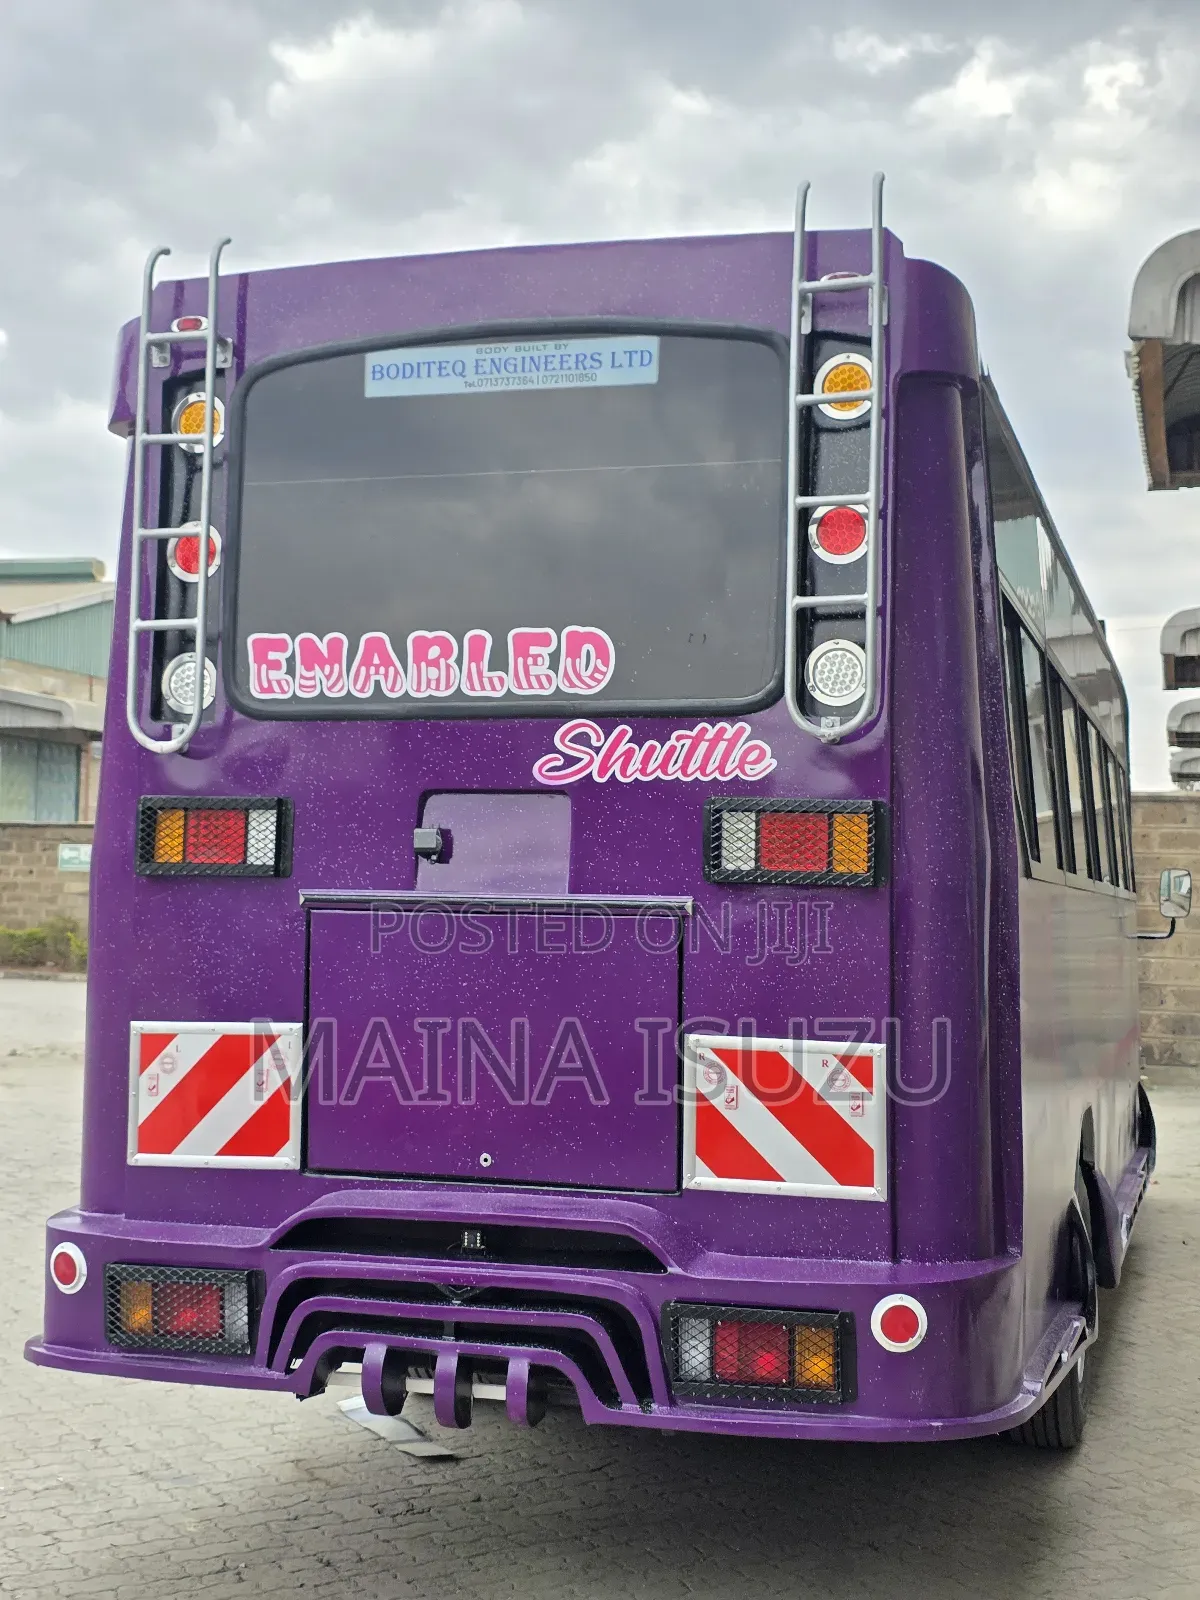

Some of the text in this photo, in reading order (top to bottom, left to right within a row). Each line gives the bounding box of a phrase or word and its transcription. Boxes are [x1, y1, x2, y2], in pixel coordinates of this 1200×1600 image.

[371, 349, 653, 381] BODITEQ ENGINEERS LTD
[476, 343, 569, 355] BODY BUILT BY
[247, 625, 616, 700] ENABLED
[532, 718, 778, 786] Shuttle
[821, 1058, 830, 1068] R
